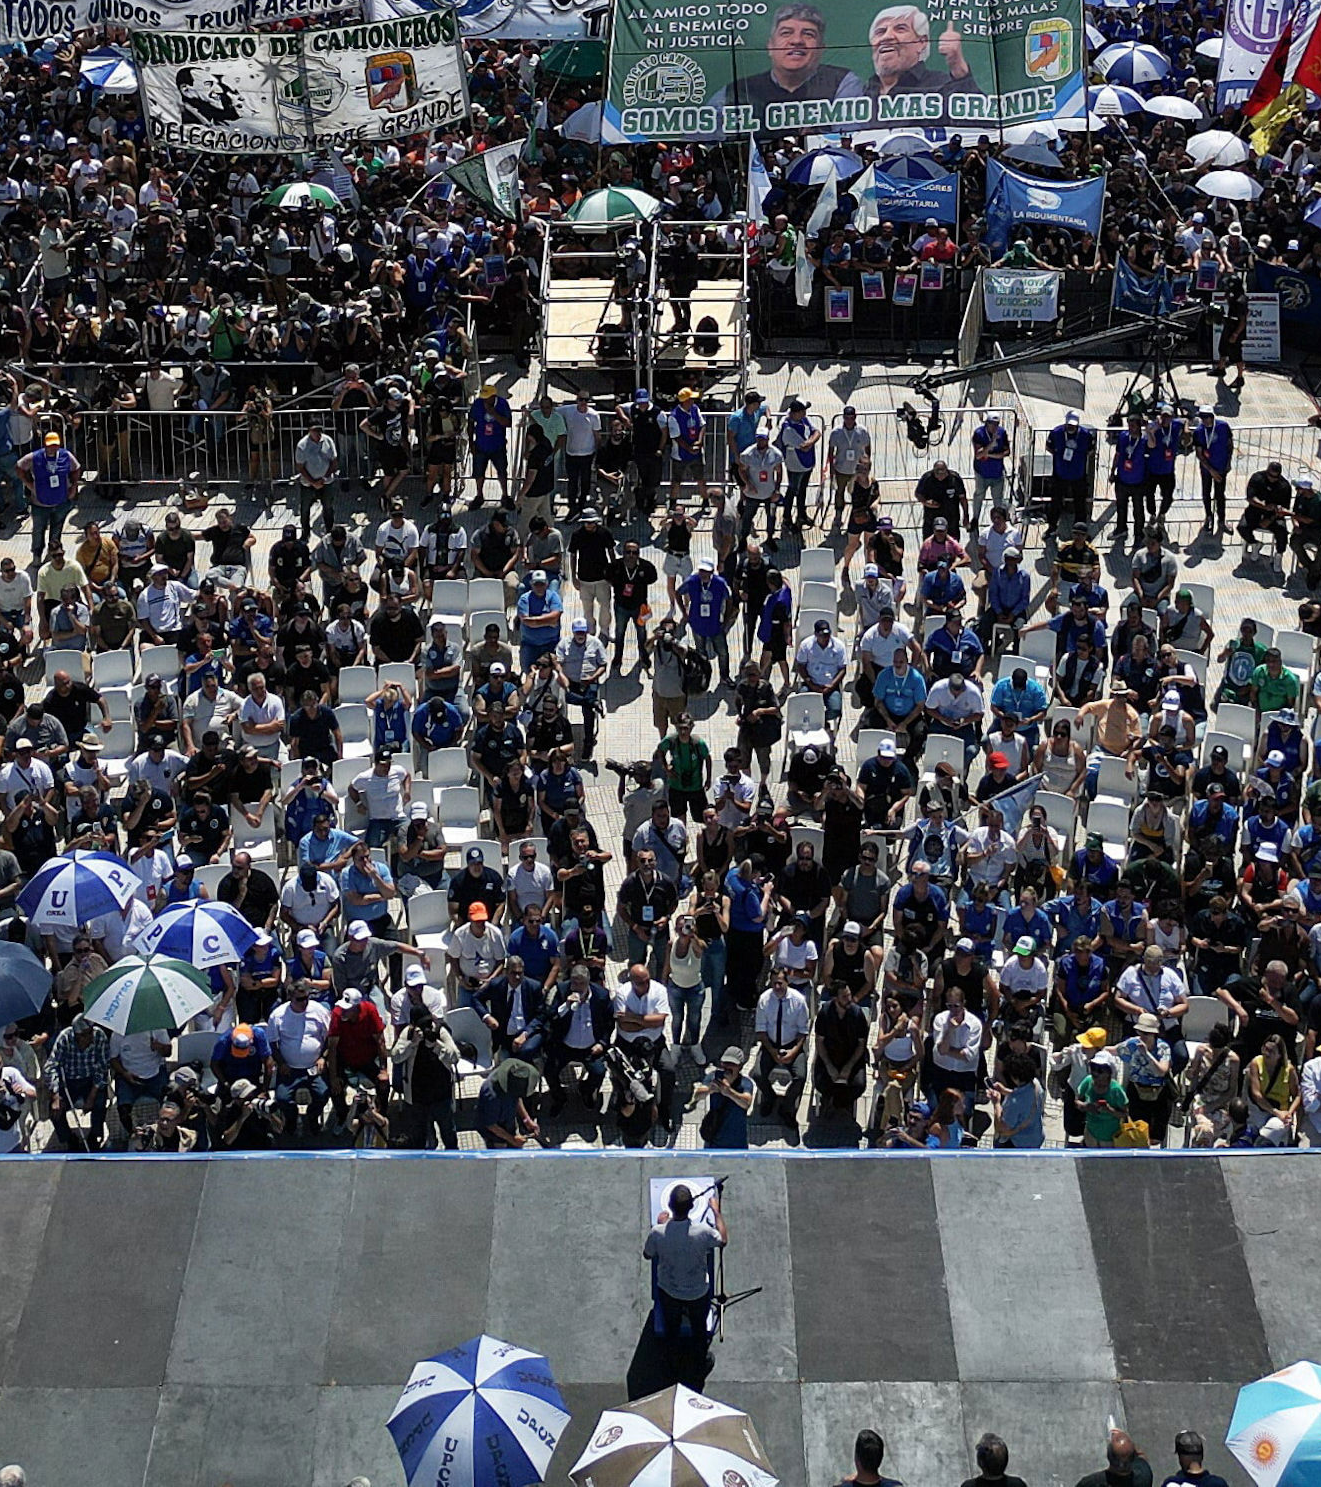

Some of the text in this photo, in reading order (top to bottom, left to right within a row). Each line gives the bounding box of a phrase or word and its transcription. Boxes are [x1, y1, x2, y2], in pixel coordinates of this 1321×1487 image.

[628, 2, 768, 20] AL AMIGO TODO
[643, 19, 750, 36] AL ENEMIGO
[930, 1, 1059, 23] NI EN LAS MALAS
[963, 20, 1023, 37] SIEMPRE
[133, 10, 457, 64] SINDICATO DE CAMIONEROS
[646, 34, 746, 49] NI JUSTICIA
[660, 53, 707, 104] CAMIONEROS
[152, 92, 464, 151] DELEGACION GRANDE
[622, 85, 1055, 136] SOMOS EL GREMIO MAS GRANDE
[516, 1407, 556, 1451] UPCN
[443, 1436, 459, 1487] UPC
